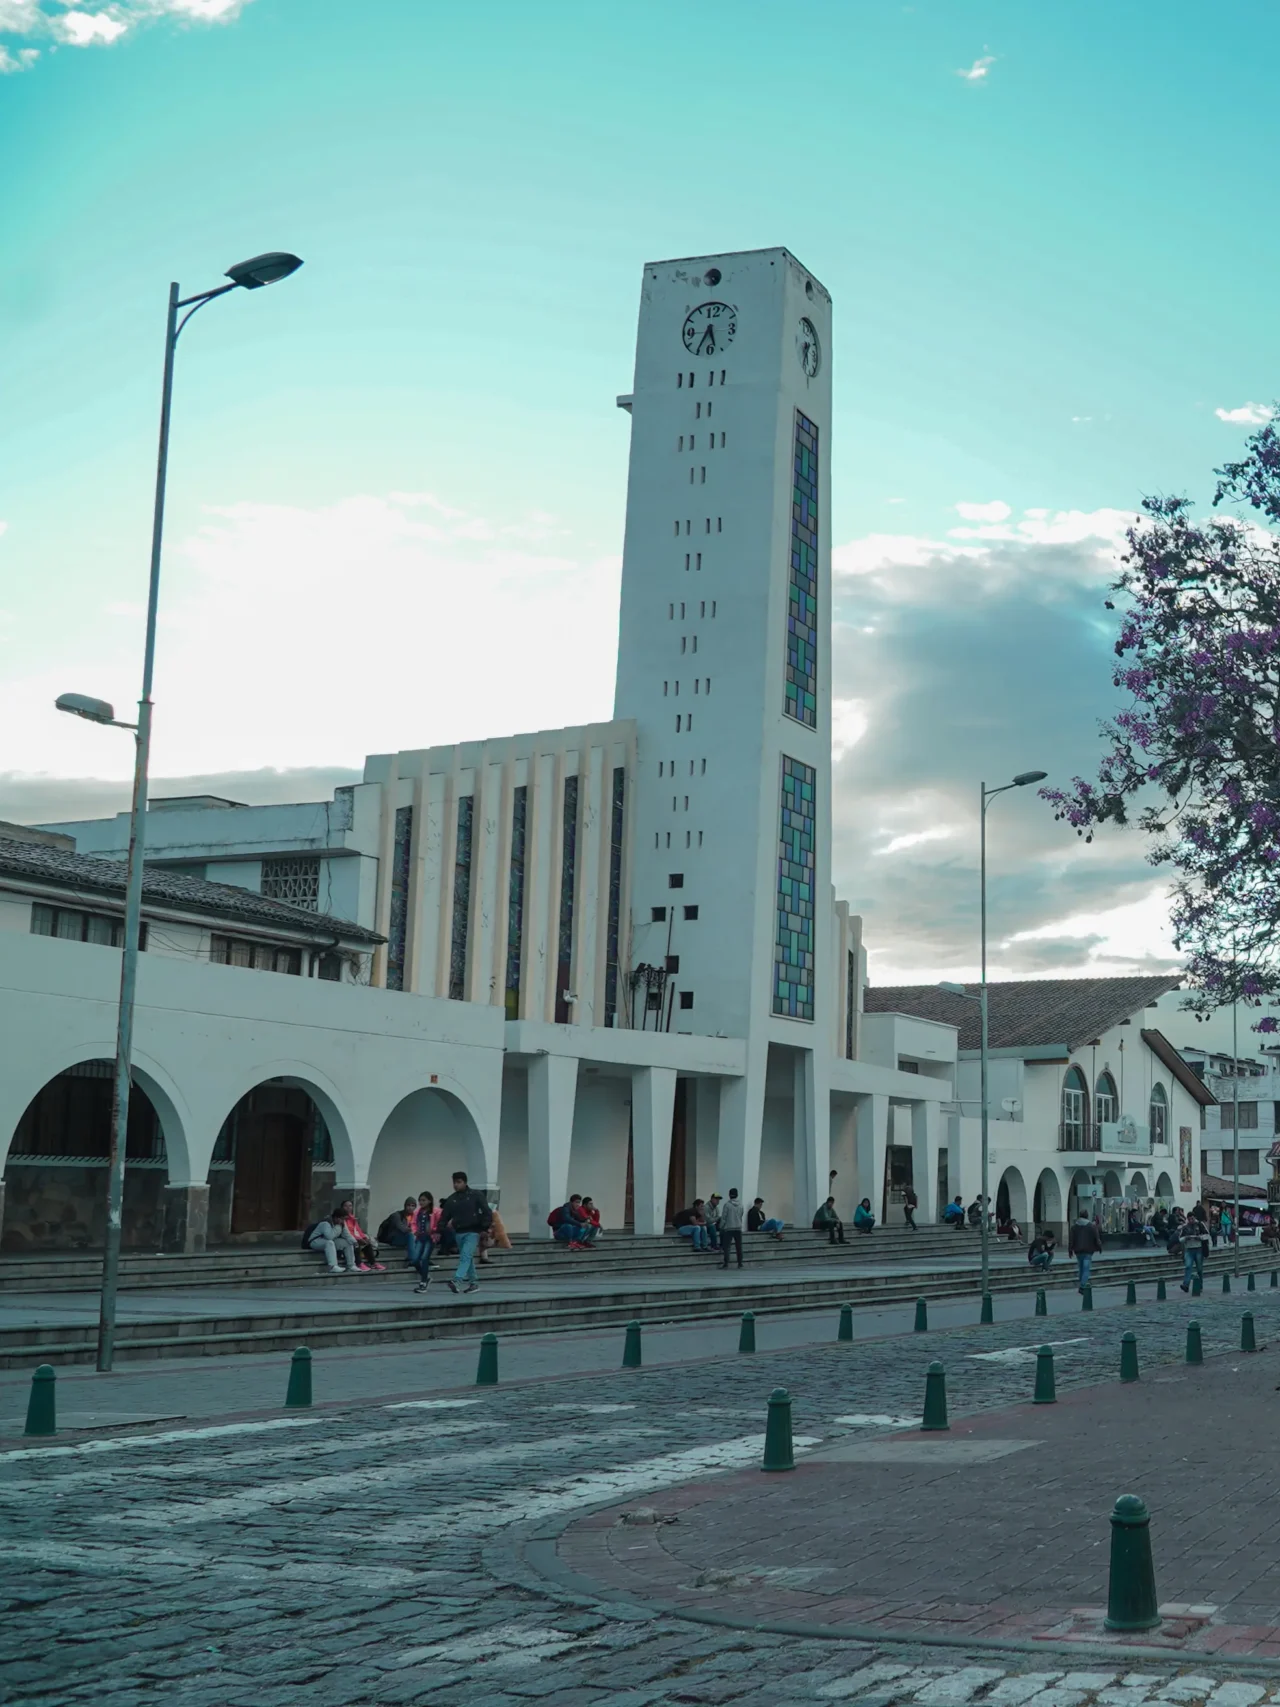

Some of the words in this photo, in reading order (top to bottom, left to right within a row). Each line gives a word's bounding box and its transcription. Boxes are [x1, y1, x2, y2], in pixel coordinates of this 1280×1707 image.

[706, 306, 720, 318] 12
[687, 328, 695, 340] 9
[728, 323, 736, 335] 3
[706, 343, 715, 355] 6
